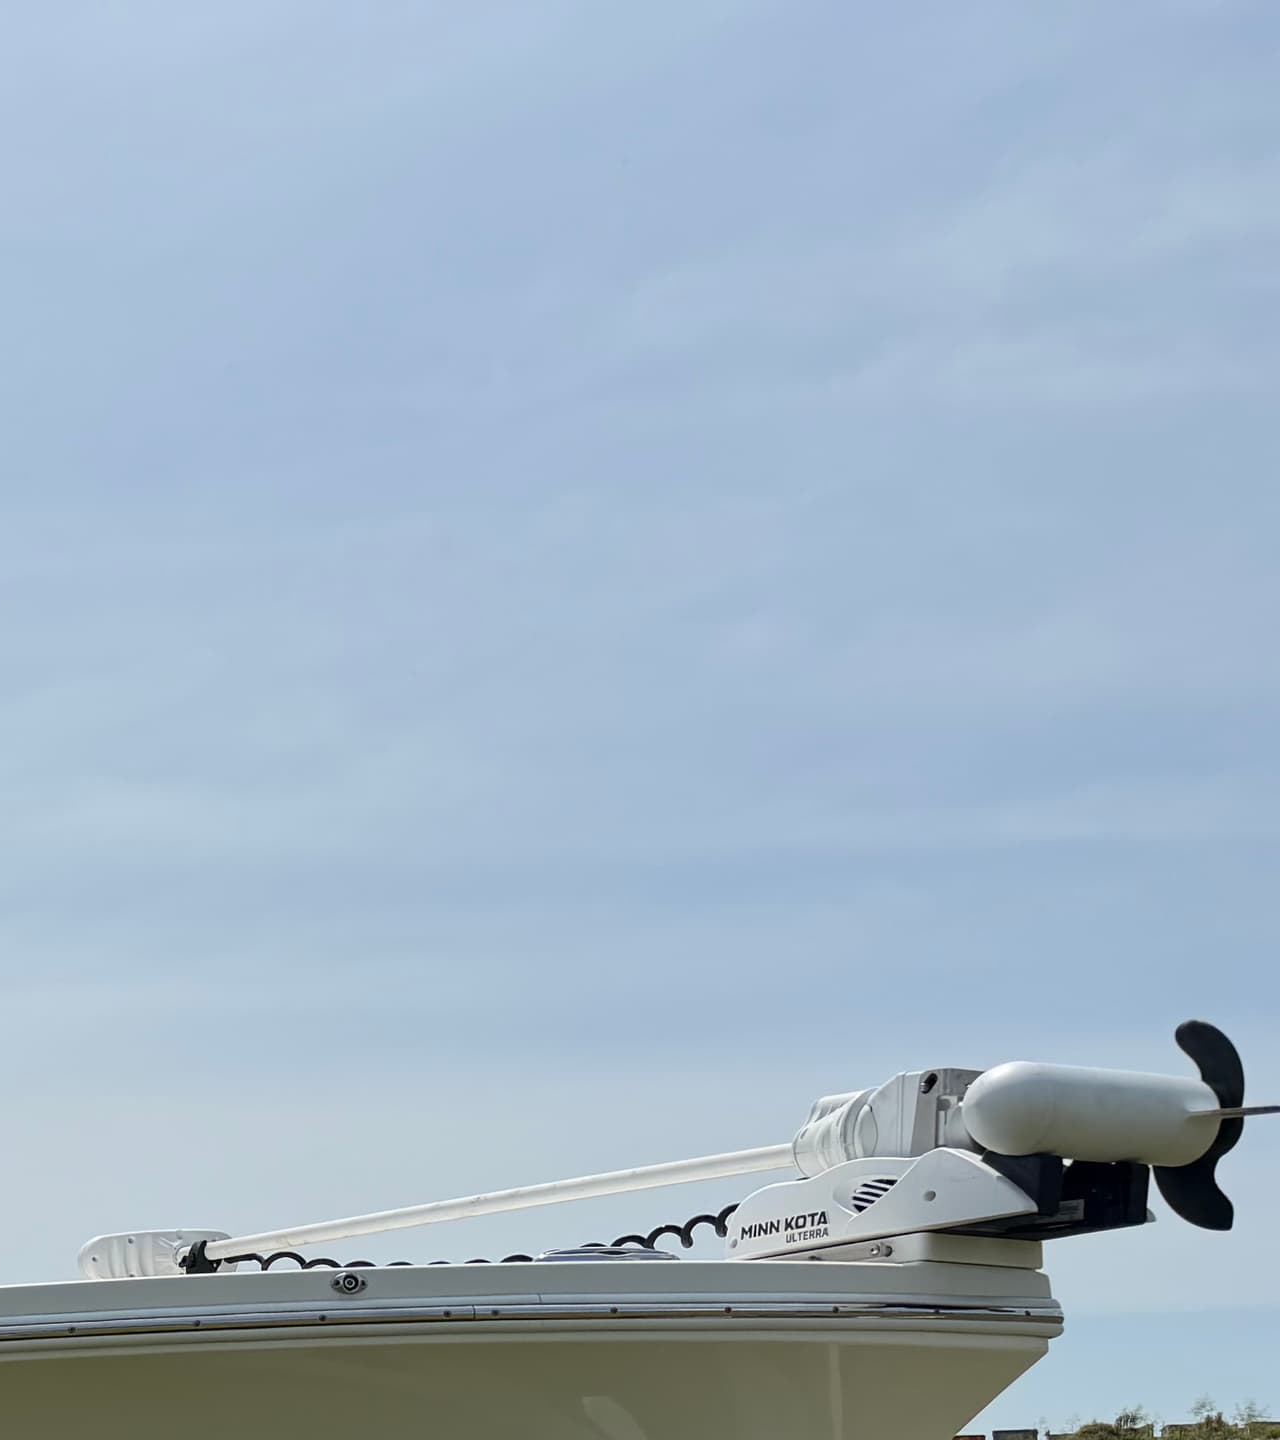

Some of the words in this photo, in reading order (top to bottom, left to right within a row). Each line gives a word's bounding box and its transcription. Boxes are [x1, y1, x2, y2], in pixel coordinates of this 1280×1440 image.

[741, 1219, 781, 1241] MINN
[784, 1211, 828, 1232] KOTA
[785, 1227, 829, 1244] ULTERRA
